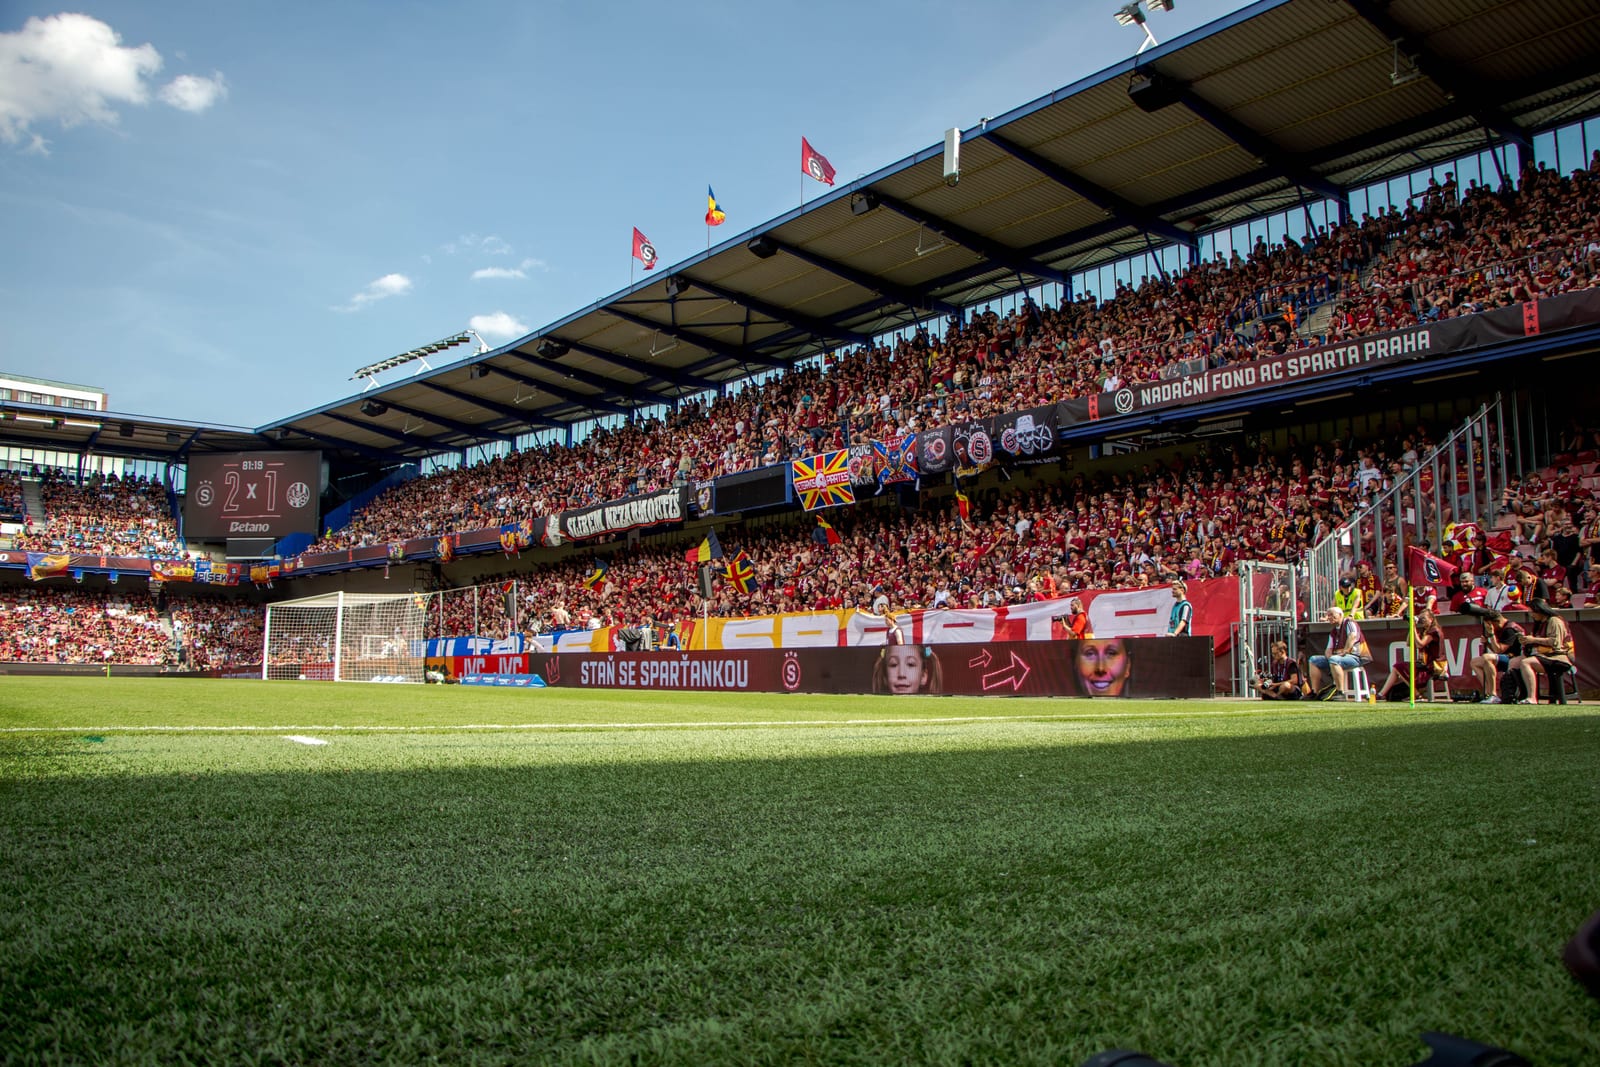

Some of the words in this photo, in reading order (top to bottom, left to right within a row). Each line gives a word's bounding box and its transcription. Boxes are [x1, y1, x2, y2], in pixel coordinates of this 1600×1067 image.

[1141, 372, 1208, 406] NADAČNÍ
[1212, 366, 1256, 392] FOND
[1259, 361, 1283, 383] AC
[1287, 345, 1360, 377] SPARTA
[1363, 330, 1431, 362] PRAHA
[242, 460, 264, 470] 81:19
[223, 471, 240, 512] 2
[265, 470, 277, 511] 1
[229, 521, 270, 533] Betano
[198, 571, 228, 583] PÍSEK
[580, 655, 615, 685] STAŇ
[619, 660, 636, 686] SE
[640, 653, 748, 688] SPARŤANKOU
